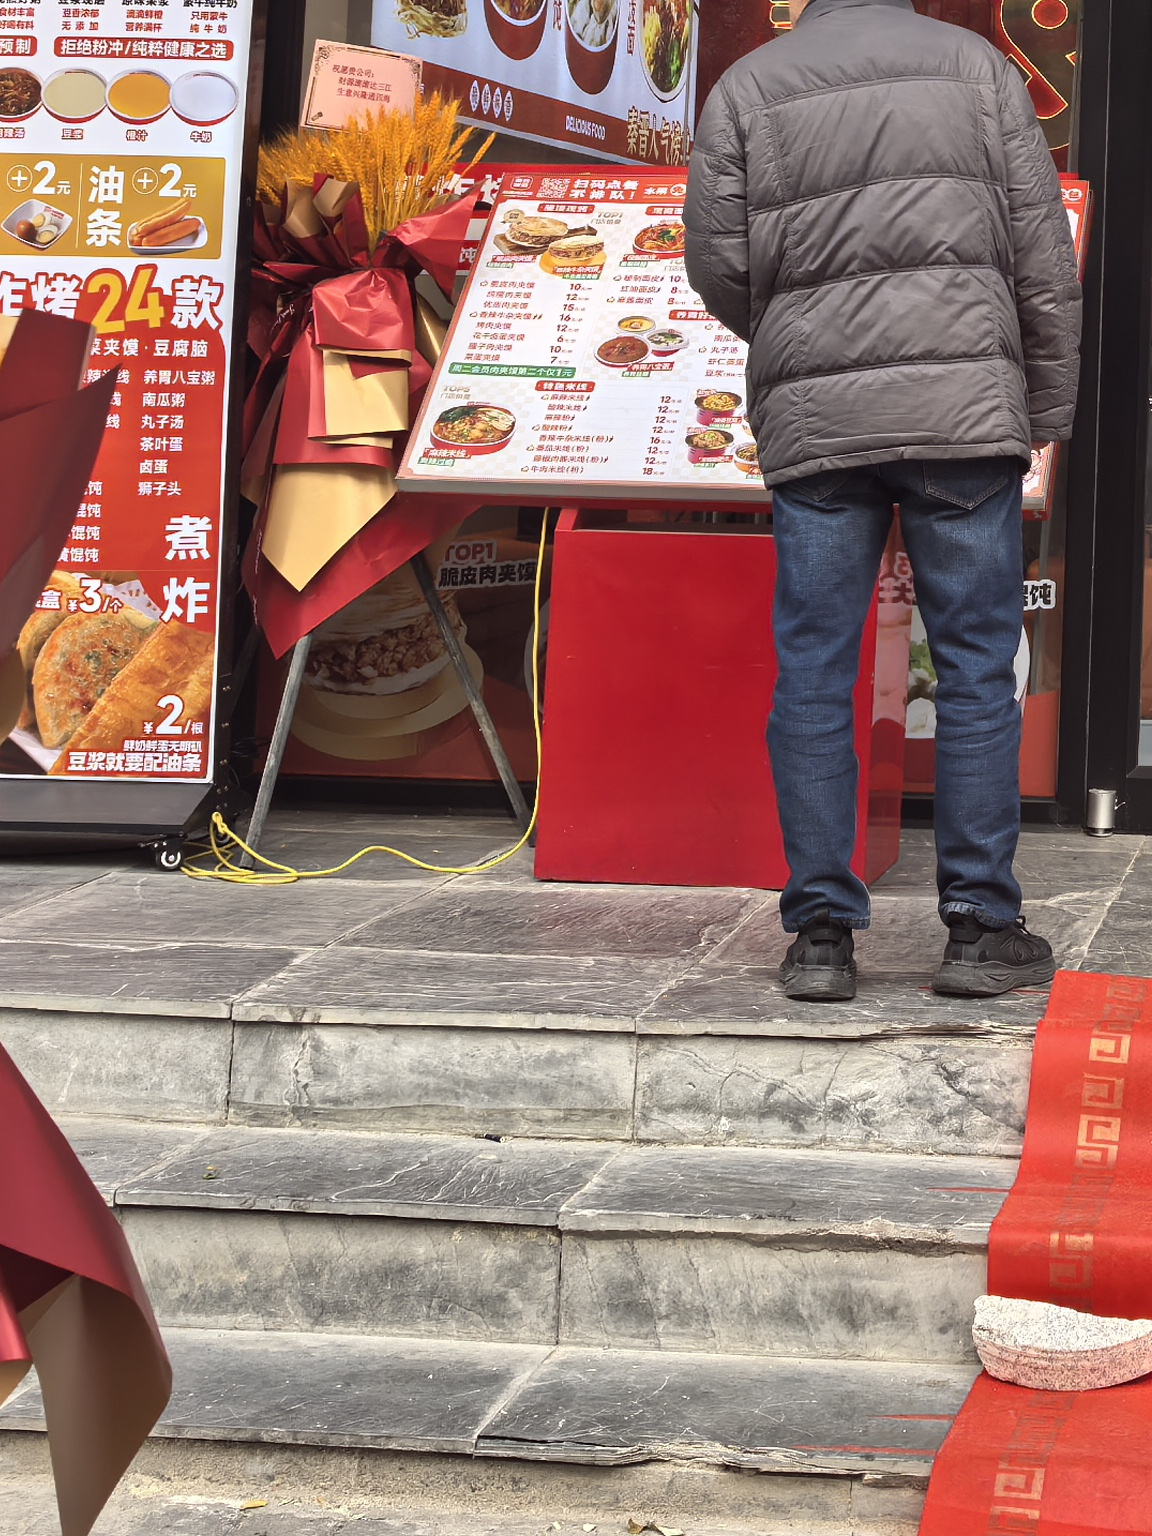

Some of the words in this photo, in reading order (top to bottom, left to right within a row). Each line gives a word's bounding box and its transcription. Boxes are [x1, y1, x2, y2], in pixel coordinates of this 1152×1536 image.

[190, 24, 227, 34] 纯牛奶
[60, 38, 228, 59] 拒绝粉冲/纯粹健康之选
[61, 128, 84, 140] 豆浆
[126, 130, 148, 142] 橙汁
[190, 130, 212, 142] 牛奶
[565, 115, 592, 136] DELICIOUS
[591, 123, 606, 140] FOOD
[573, 178, 639, 190] 扫码点餐
[569, 189, 636, 200] 不排队!
[85, 165, 125, 248] 油条
[143, 369, 216, 386] 养胃八宝粥
[451, 364, 574, 377] 周二会员肉夹馍第二个仅1元
[142, 392, 185, 408] 南瓜粥
[141, 415, 184, 430] 丸子汤
[139, 437, 183, 452] 茶叶蛋
[139, 459, 168, 475] 卤蛋
[137, 480, 181, 496] 狮子头
[164, 515, 213, 561] 煮
[444, 542, 494, 561] TOP1
[438, 561, 537, 587] 脆皮肉夹馍
[160, 576, 211, 624] 炸
[67, 751, 202, 773] 豆浆就要配油条
